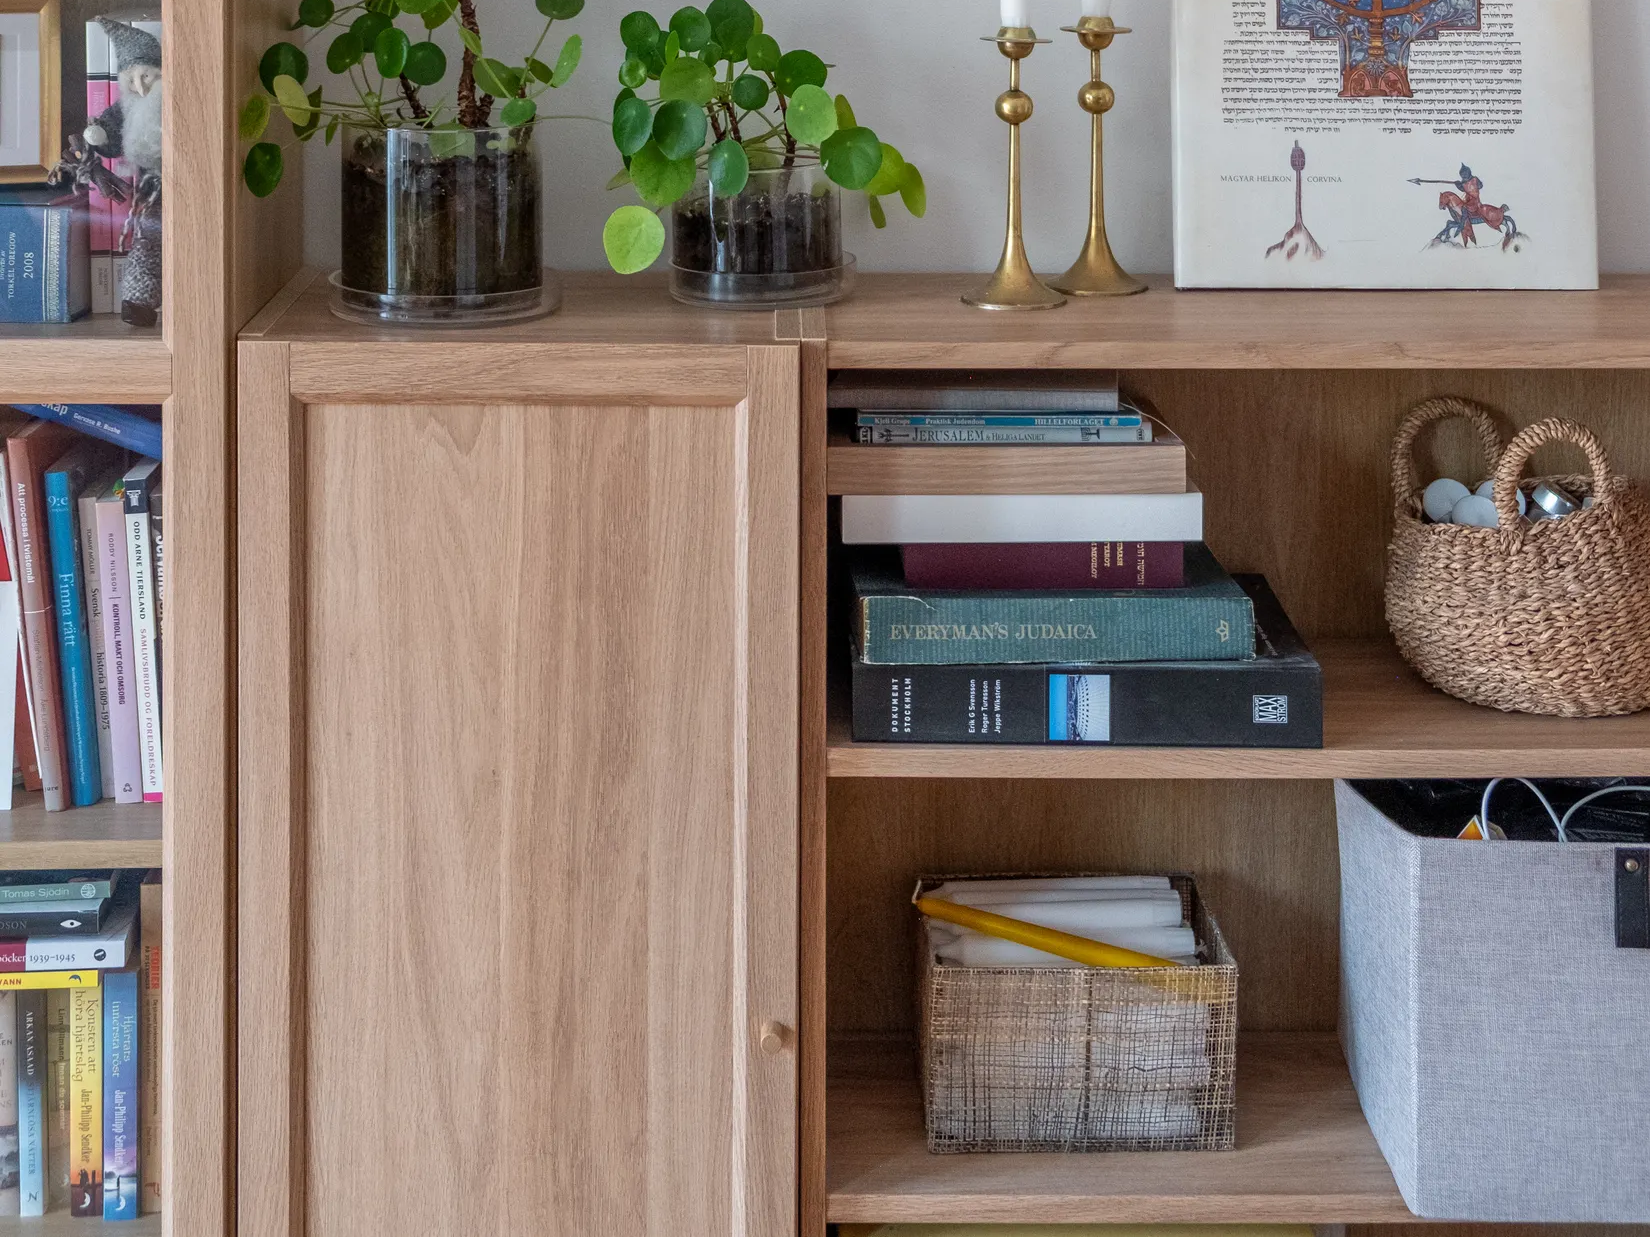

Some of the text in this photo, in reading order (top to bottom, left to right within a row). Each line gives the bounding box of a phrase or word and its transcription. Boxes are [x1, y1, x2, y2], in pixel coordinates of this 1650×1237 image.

[1220, 175, 1342, 183] MAGYAR HELIKON CORVINA
[23, 251, 35, 279] 2008
[7, 268, 15, 299] TORKEL
[912, 427, 984, 442] JERUSALEM
[1018, 433, 1046, 441] LANDET
[17, 483, 27, 497] Att
[18, 497, 30, 538] processa
[108, 533, 116, 557] RODDY
[24, 544, 35, 584] tvistemål
[58, 572, 76, 647] Finna rätt
[112, 603, 121, 639] KONTROLL,
[91, 588, 101, 618] Svensk
[96, 652, 106, 684] historia
[1015, 624, 1098, 640] JUDAICA
[114, 640, 123, 660] MAKT
[133, 521, 156, 786] ODD ARNE TJERSLAND SAMLIVSBRUDD OG FORELDRESKAP
[116, 660, 124, 675] OCH
[117, 676, 125, 705] OMSORG
[891, 678, 899, 733] DOKUMENT
[904, 678, 912, 733] STOCKHOLM
[968, 679, 976, 711] Svensson
[981, 712, 990, 734] Roger
[994, 713, 1002, 734] Jeppe
[1258, 697, 1277, 722] MAX
[968, 718, 976, 734] Erik
[2, 889, 36, 899] Tomas
[26, 1011, 34, 1041] ARKAN
[71, 989, 87, 1083] höra hjärtslag
[86, 998, 99, 1074] Konsten att
[112, 1001, 122, 1078] innersta röst
[120, 1015, 136, 1062] Hjärtats
[27, 1045, 35, 1075] ASAAD
[78, 1088, 93, 1163] Jan-Philipp Sendker
[112, 1089, 127, 1164] Jan-Philipp Sendker
